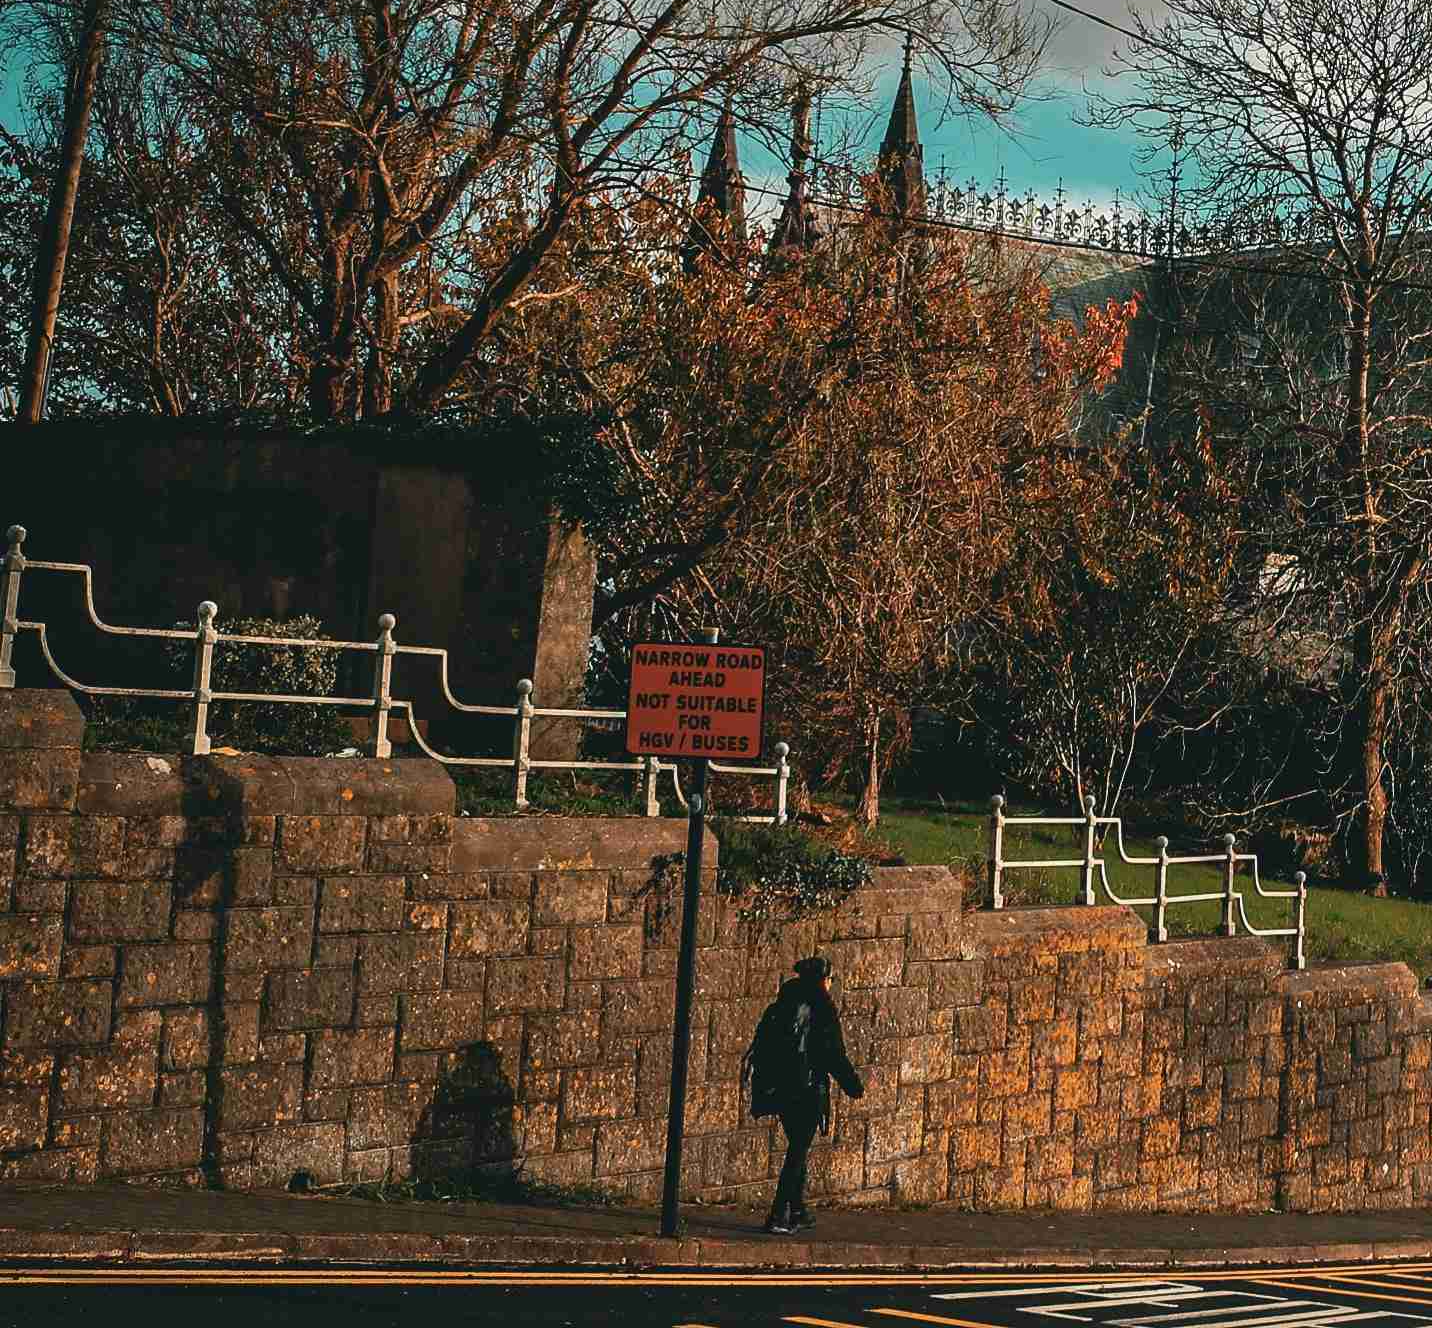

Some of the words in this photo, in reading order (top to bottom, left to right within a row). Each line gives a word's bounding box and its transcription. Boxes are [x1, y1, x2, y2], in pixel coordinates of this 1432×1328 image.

[635, 650, 710, 668] NARROW
[715, 653, 762, 670] ROAD
[669, 673, 726, 688] AHEAD
[635, 693, 670, 709] NOT
[676, 694, 757, 713] SUITABLE
[678, 714, 712, 730] FOR
[639, 732, 674, 748] HGV
[679, 733, 687, 750] /
[692, 734, 749, 752] BUSES
